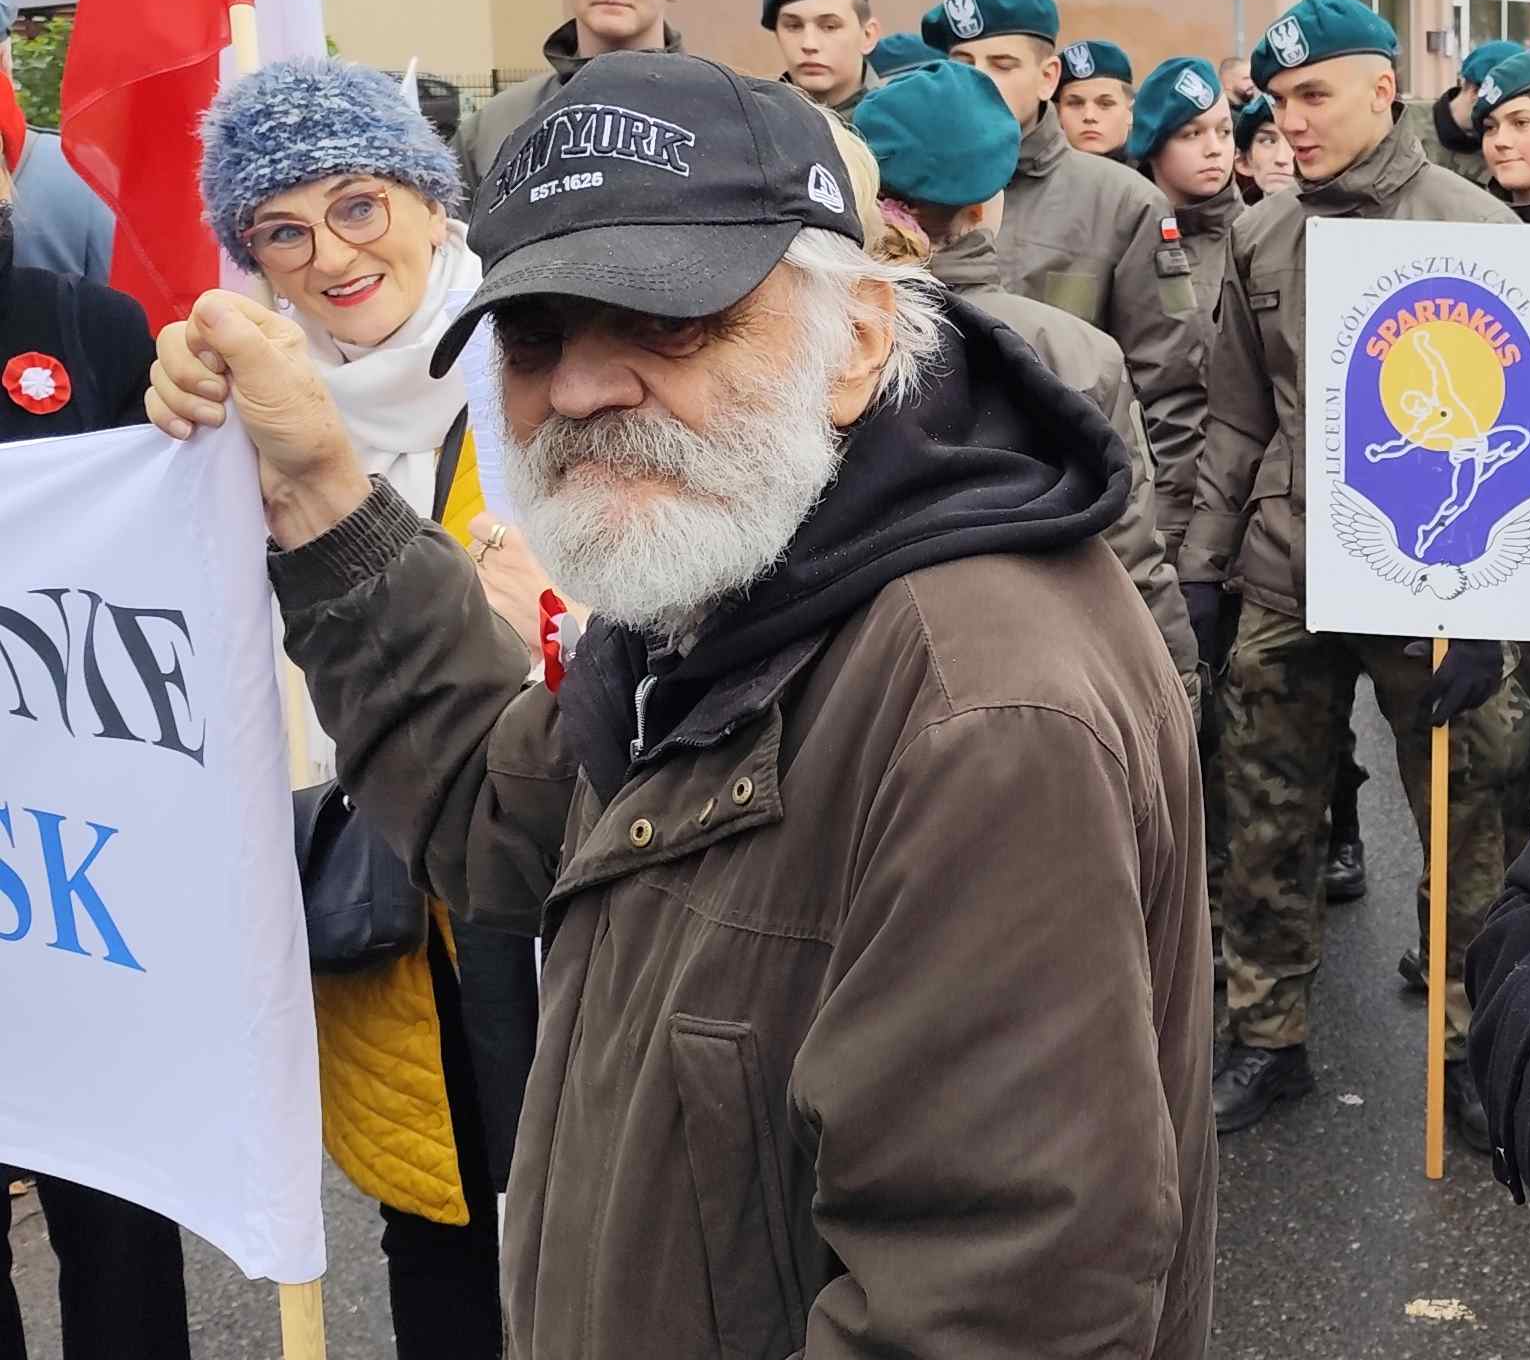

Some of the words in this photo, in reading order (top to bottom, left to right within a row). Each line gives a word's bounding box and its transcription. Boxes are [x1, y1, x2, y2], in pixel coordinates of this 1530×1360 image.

[557, 104, 695, 177] YORK
[1365, 297, 1522, 369] SPARTAKUS
[1325, 386, 1341, 475] LICEUM
